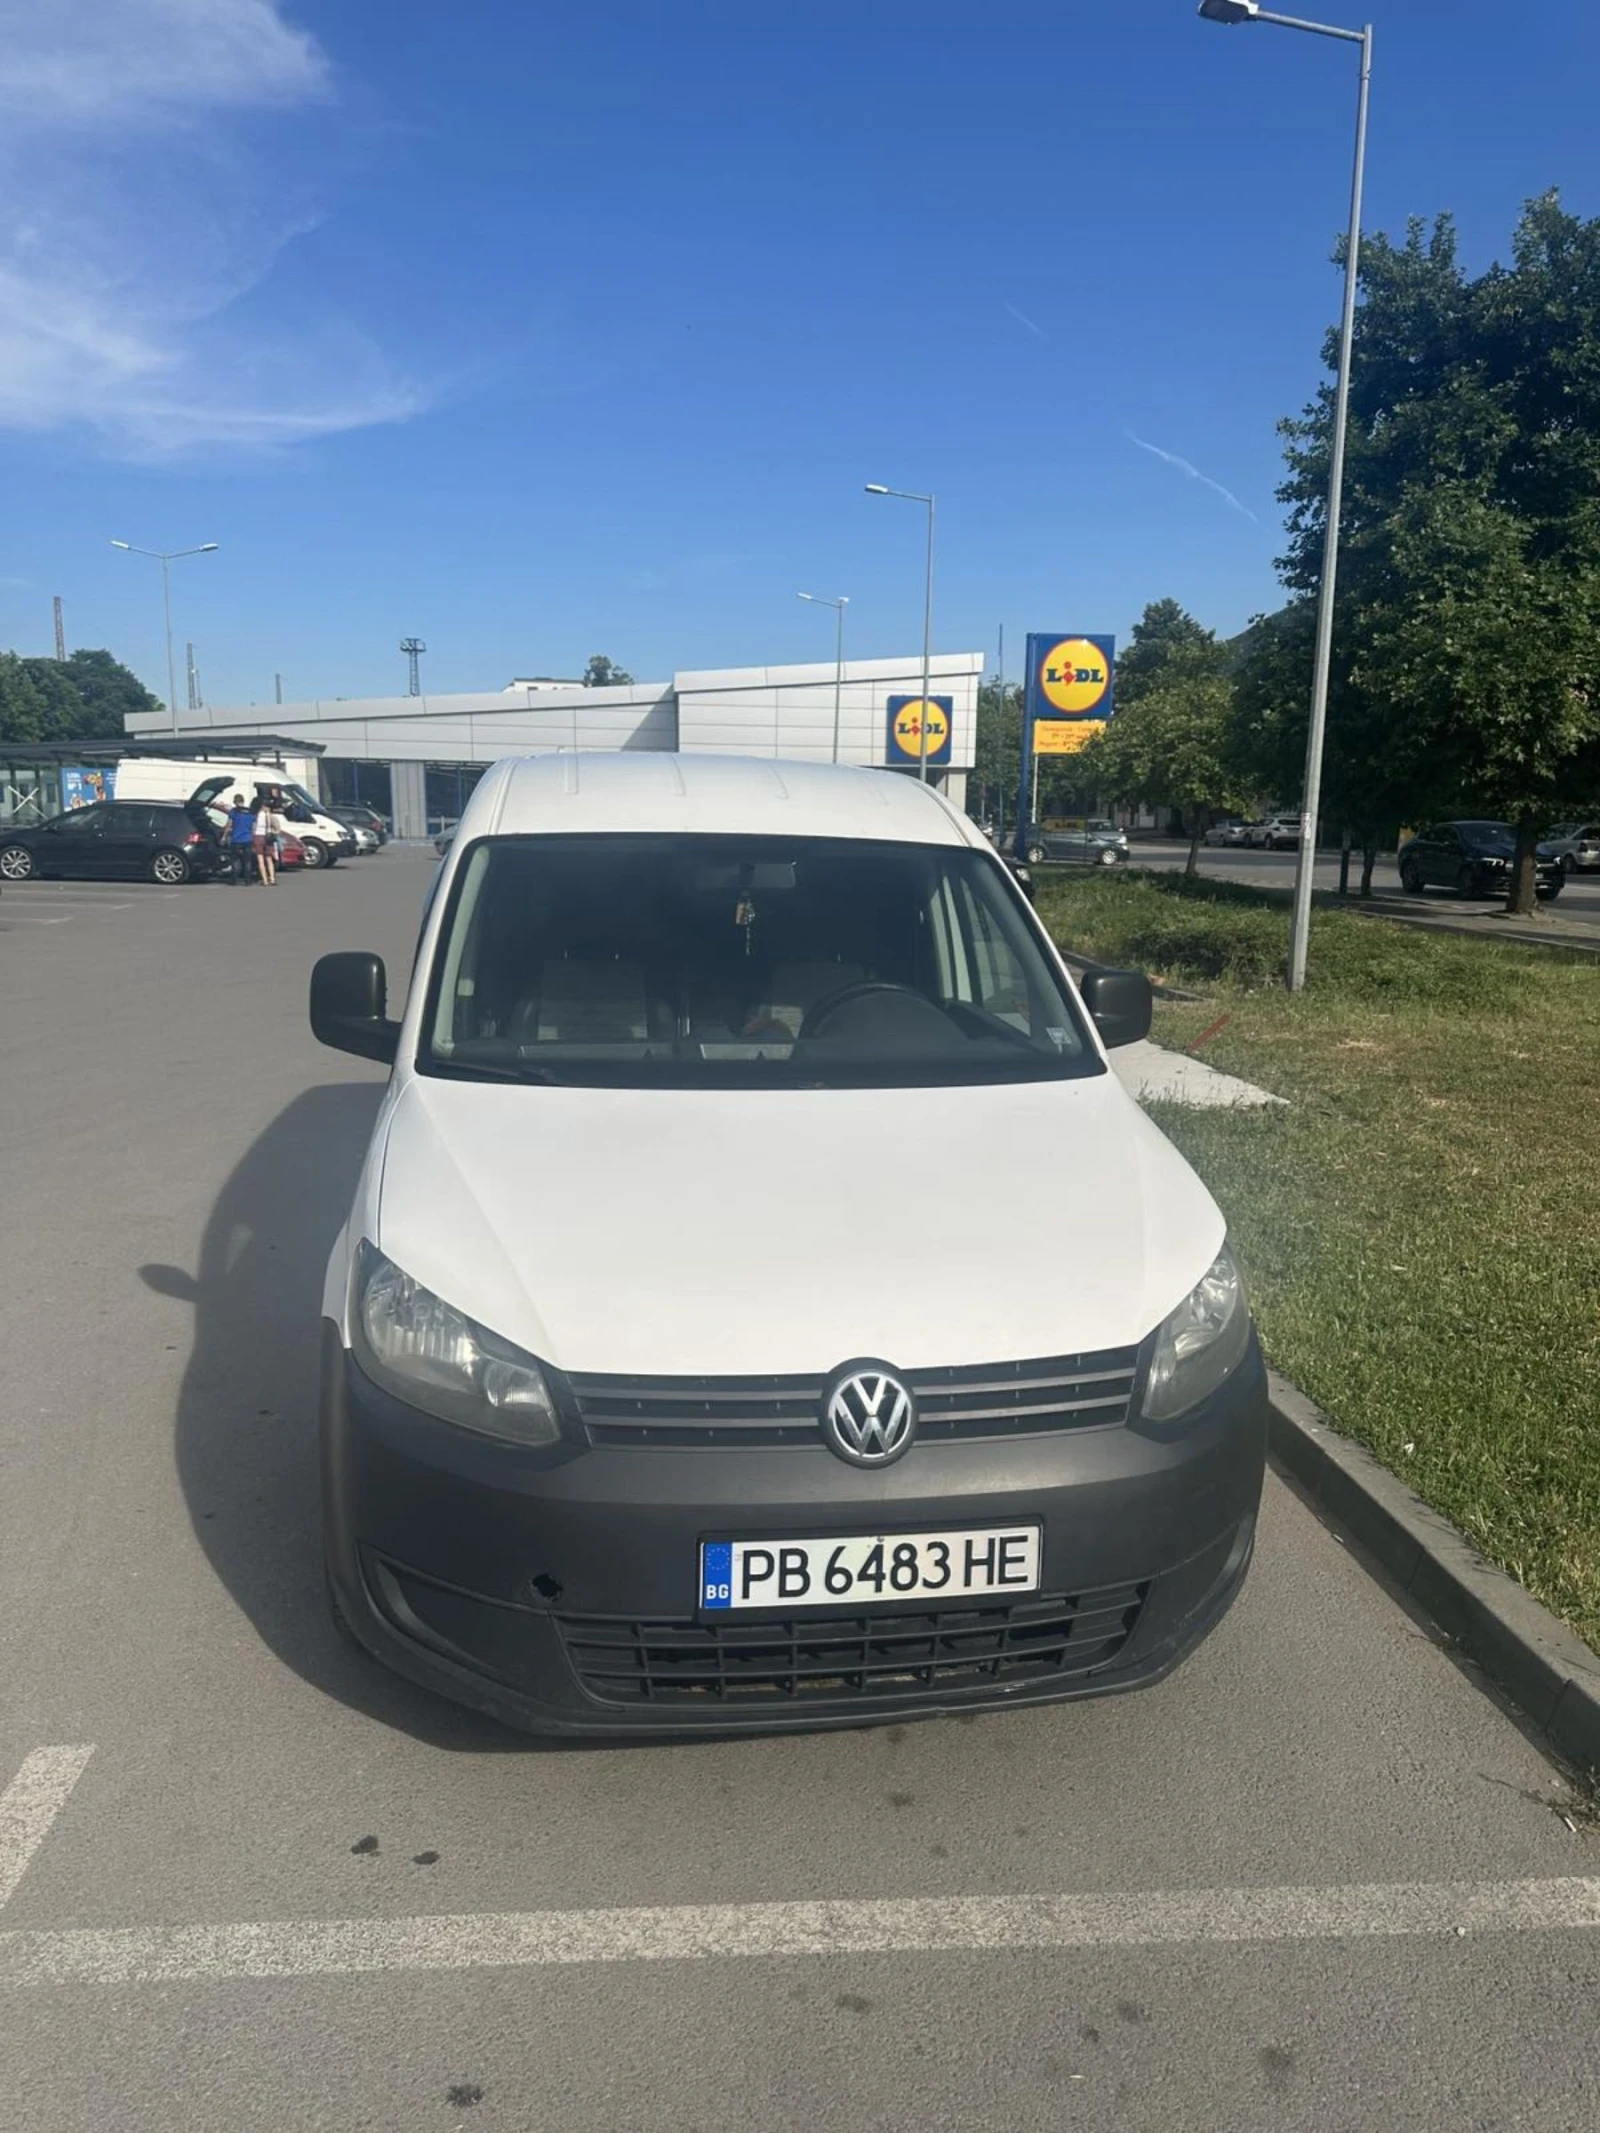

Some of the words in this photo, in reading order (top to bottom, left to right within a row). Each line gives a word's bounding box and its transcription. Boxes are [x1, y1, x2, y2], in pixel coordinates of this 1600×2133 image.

[742, 1548, 811, 1599] PB
[824, 1541, 951, 1595] 6483
[964, 1535, 1028, 1587] HE
[706, 1584, 729, 1599] BG
